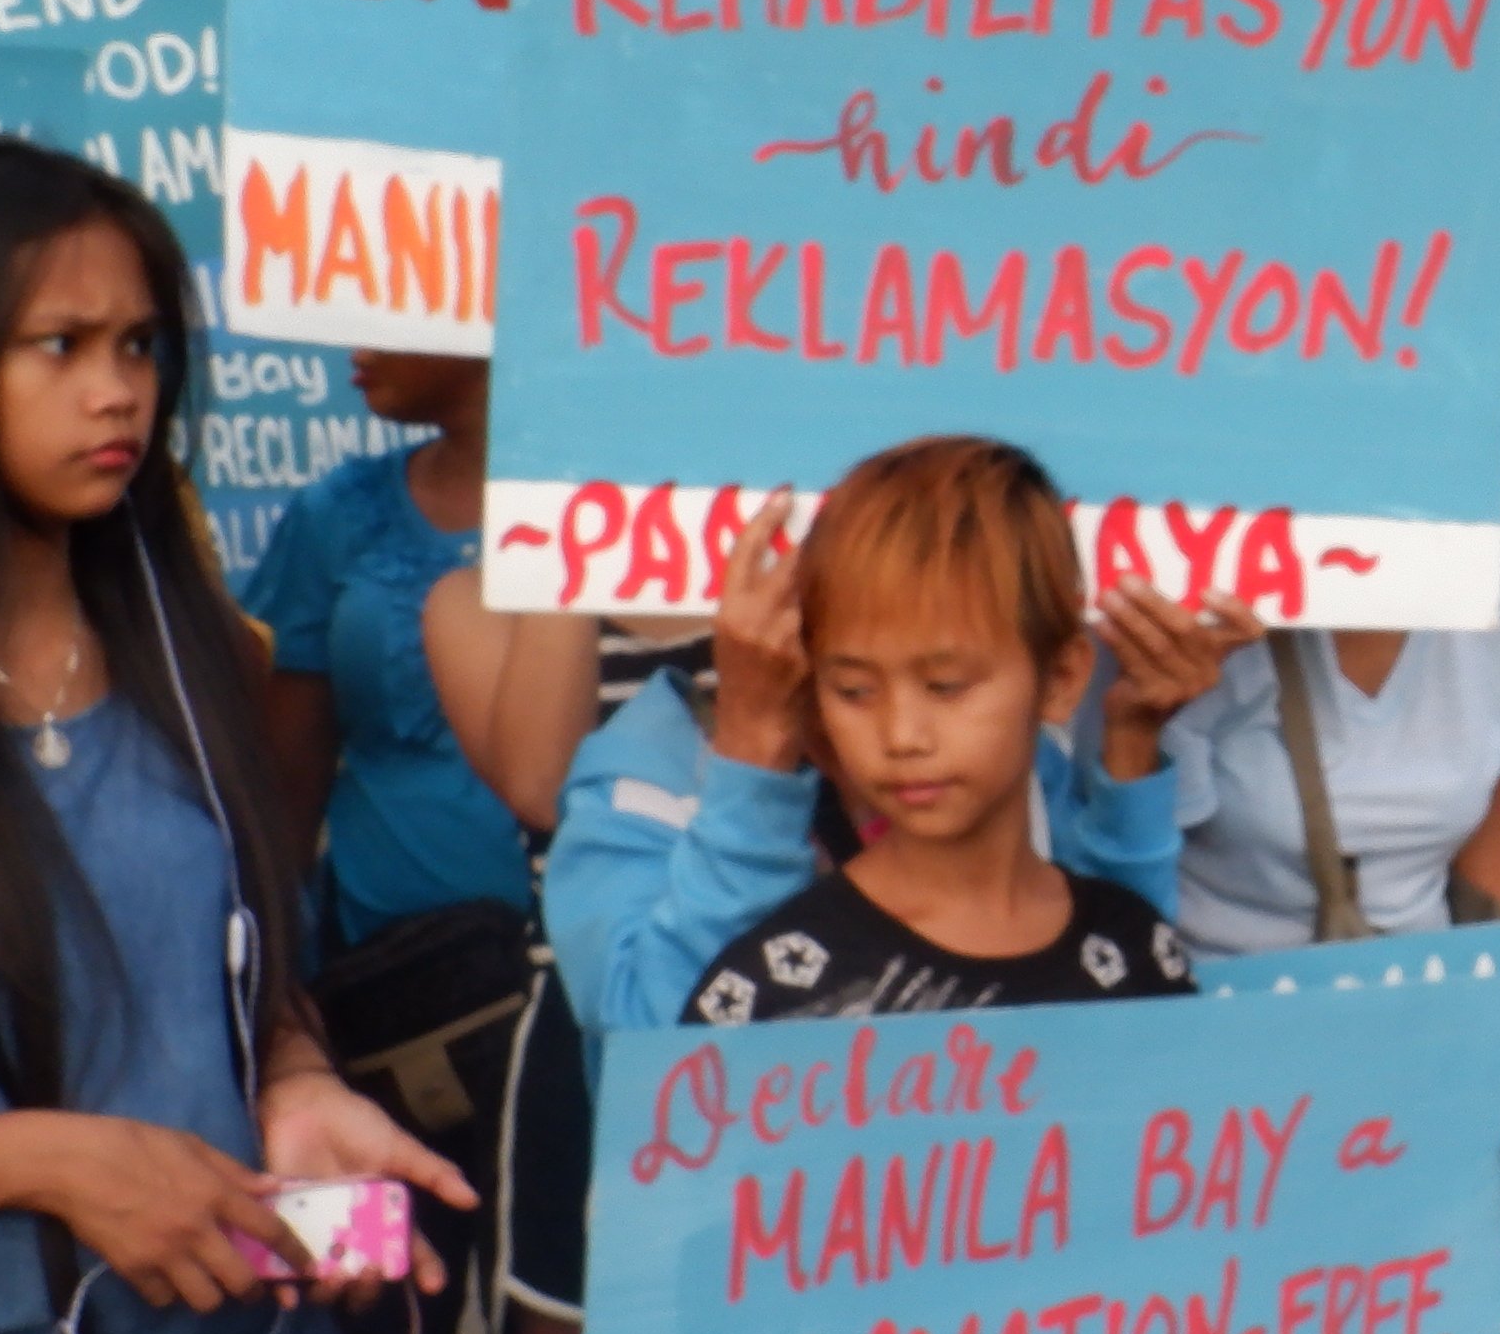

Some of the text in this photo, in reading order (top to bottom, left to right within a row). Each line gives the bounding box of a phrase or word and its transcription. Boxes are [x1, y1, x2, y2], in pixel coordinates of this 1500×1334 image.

[85, 25, 221, 101] OD!
[570, 193, 1452, 378] REKLAMASYON!
[630, 1021, 1043, 1188] Declare
[726, 1091, 1411, 1307] MANILA BAY a
